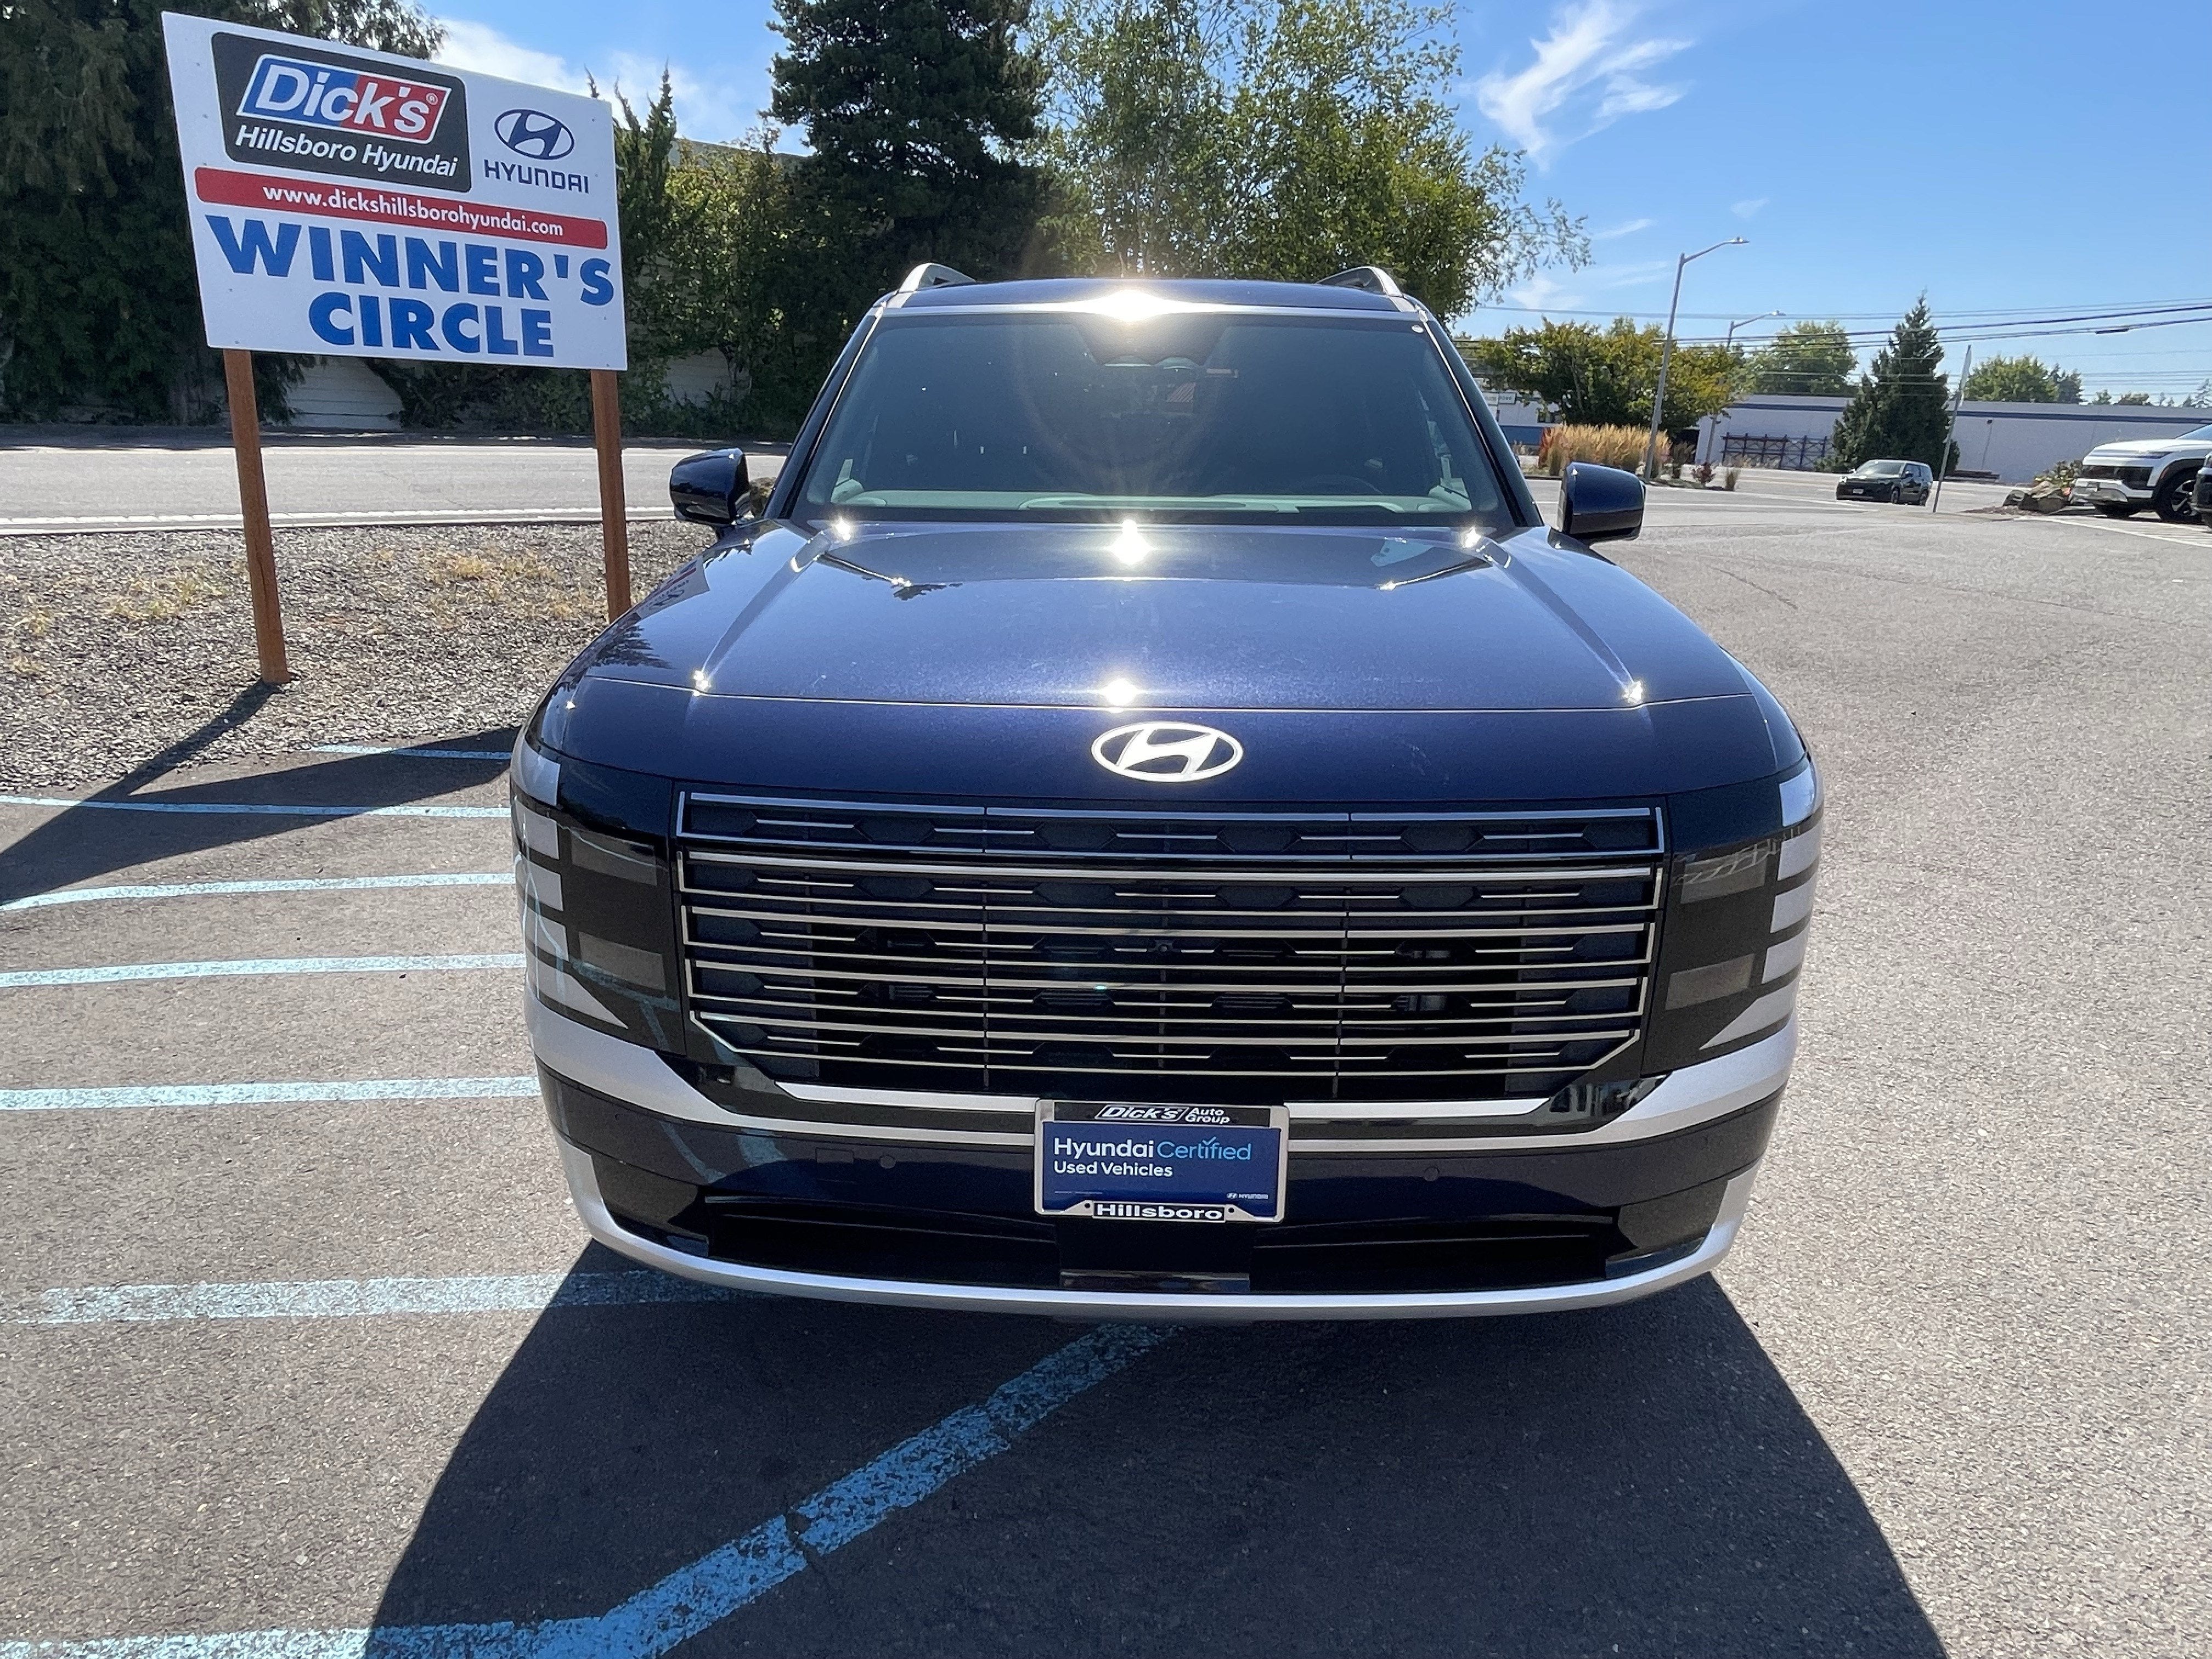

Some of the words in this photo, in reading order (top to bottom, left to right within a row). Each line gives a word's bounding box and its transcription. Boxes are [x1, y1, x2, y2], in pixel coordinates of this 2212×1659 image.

[235, 124, 357, 162] Hillsboro
[361, 143, 459, 177] Hyundai
[484, 159, 589, 194] HYUNDAI
[263, 185, 563, 237] www.dickshillsborohyundai.com
[204, 214, 614, 307] WINNER'S
[308, 291, 554, 358] CIRCLE
[1185, 1113, 1231, 1125] Group
[1189, 1107, 1224, 1116] Auto
[1053, 1137, 1154, 1160] Hyundai
[1156, 1137, 1252, 1161] Certified
[1053, 1160, 1098, 1175] Used
[1101, 1161, 1173, 1177] Vehicles
[1097, 1203, 1223, 1221] Hillsboro
